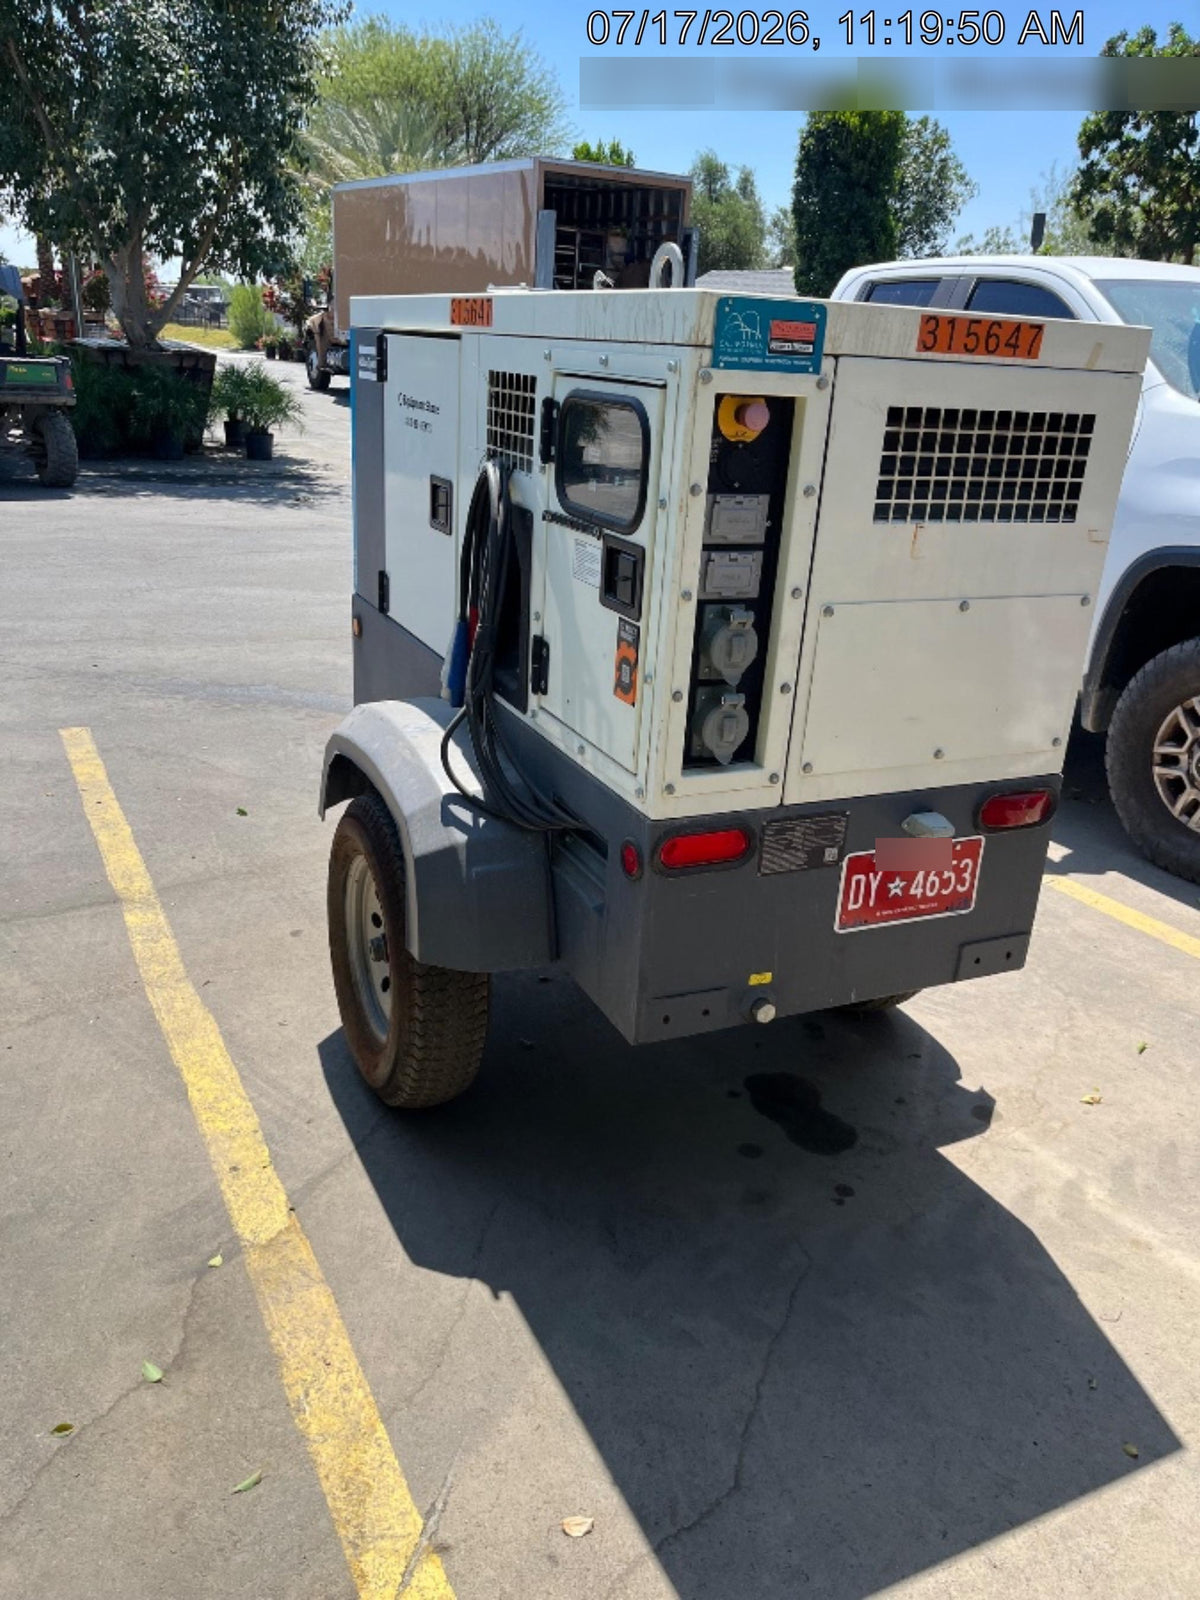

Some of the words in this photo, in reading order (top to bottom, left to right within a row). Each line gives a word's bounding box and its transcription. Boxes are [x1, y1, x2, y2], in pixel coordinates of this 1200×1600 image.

[451, 298, 492, 326] 315647
[921, 315, 1043, 356] 315647
[848, 871, 883, 910] DY
[909, 858, 973, 898] 4653
